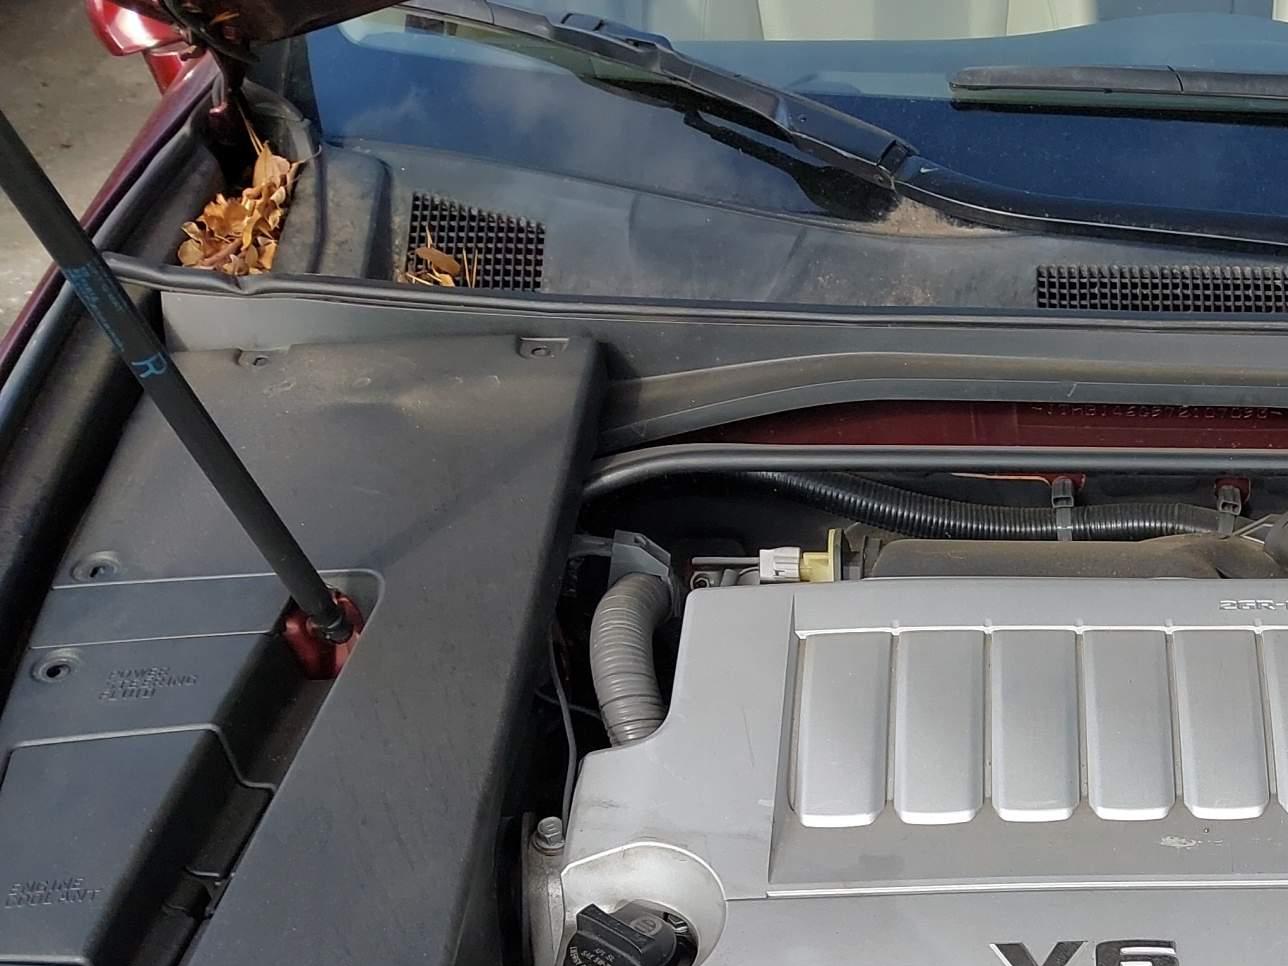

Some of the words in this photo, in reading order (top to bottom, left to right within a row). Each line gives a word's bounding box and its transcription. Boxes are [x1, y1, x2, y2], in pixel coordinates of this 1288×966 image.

[106, 674, 198, 689] STEERING
[9, 877, 84, 895] ENGINE
[4, 888, 102, 909] COOLANT
